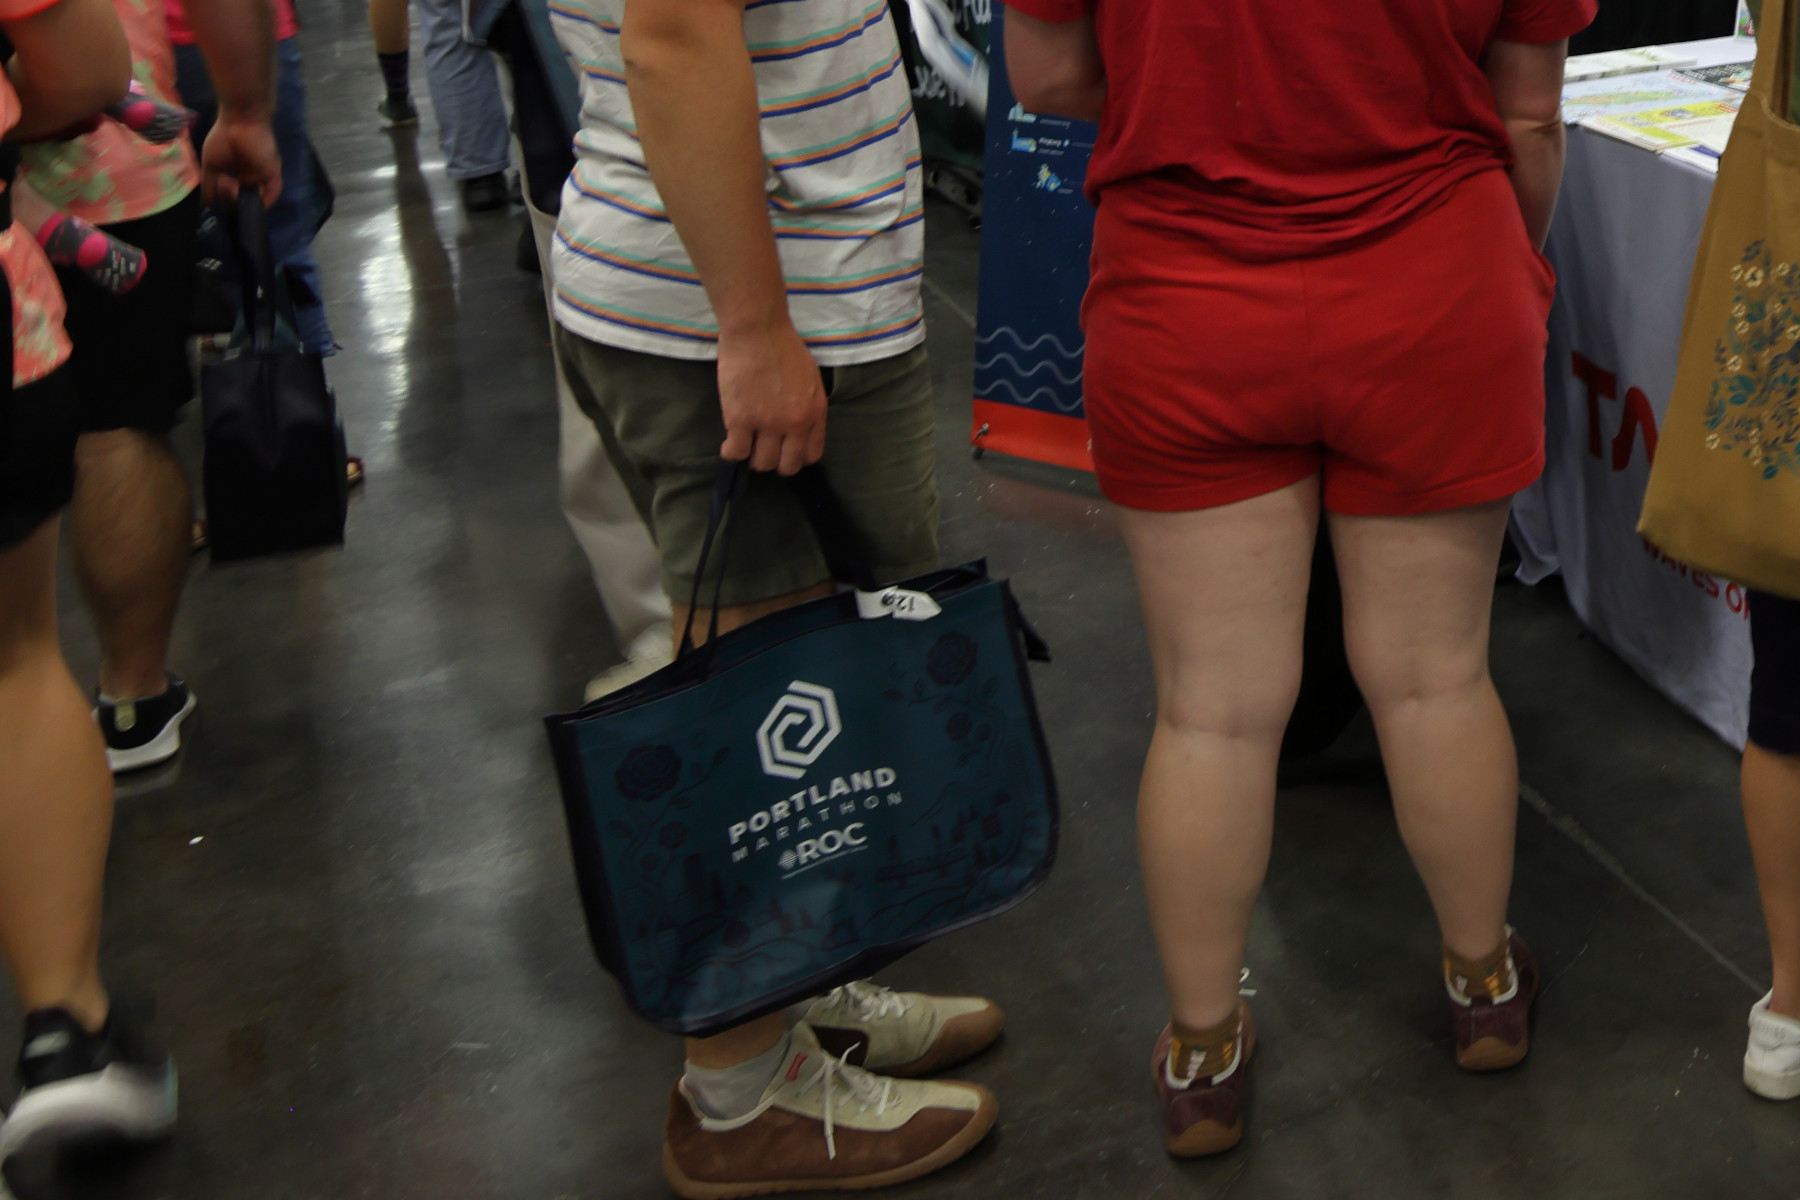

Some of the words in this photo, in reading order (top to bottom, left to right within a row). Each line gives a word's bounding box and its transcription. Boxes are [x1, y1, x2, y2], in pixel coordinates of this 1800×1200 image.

[727, 766, 897, 846] PORTLAND
[731, 791, 903, 864] MARATHON
[795, 821, 868, 866] ROC
